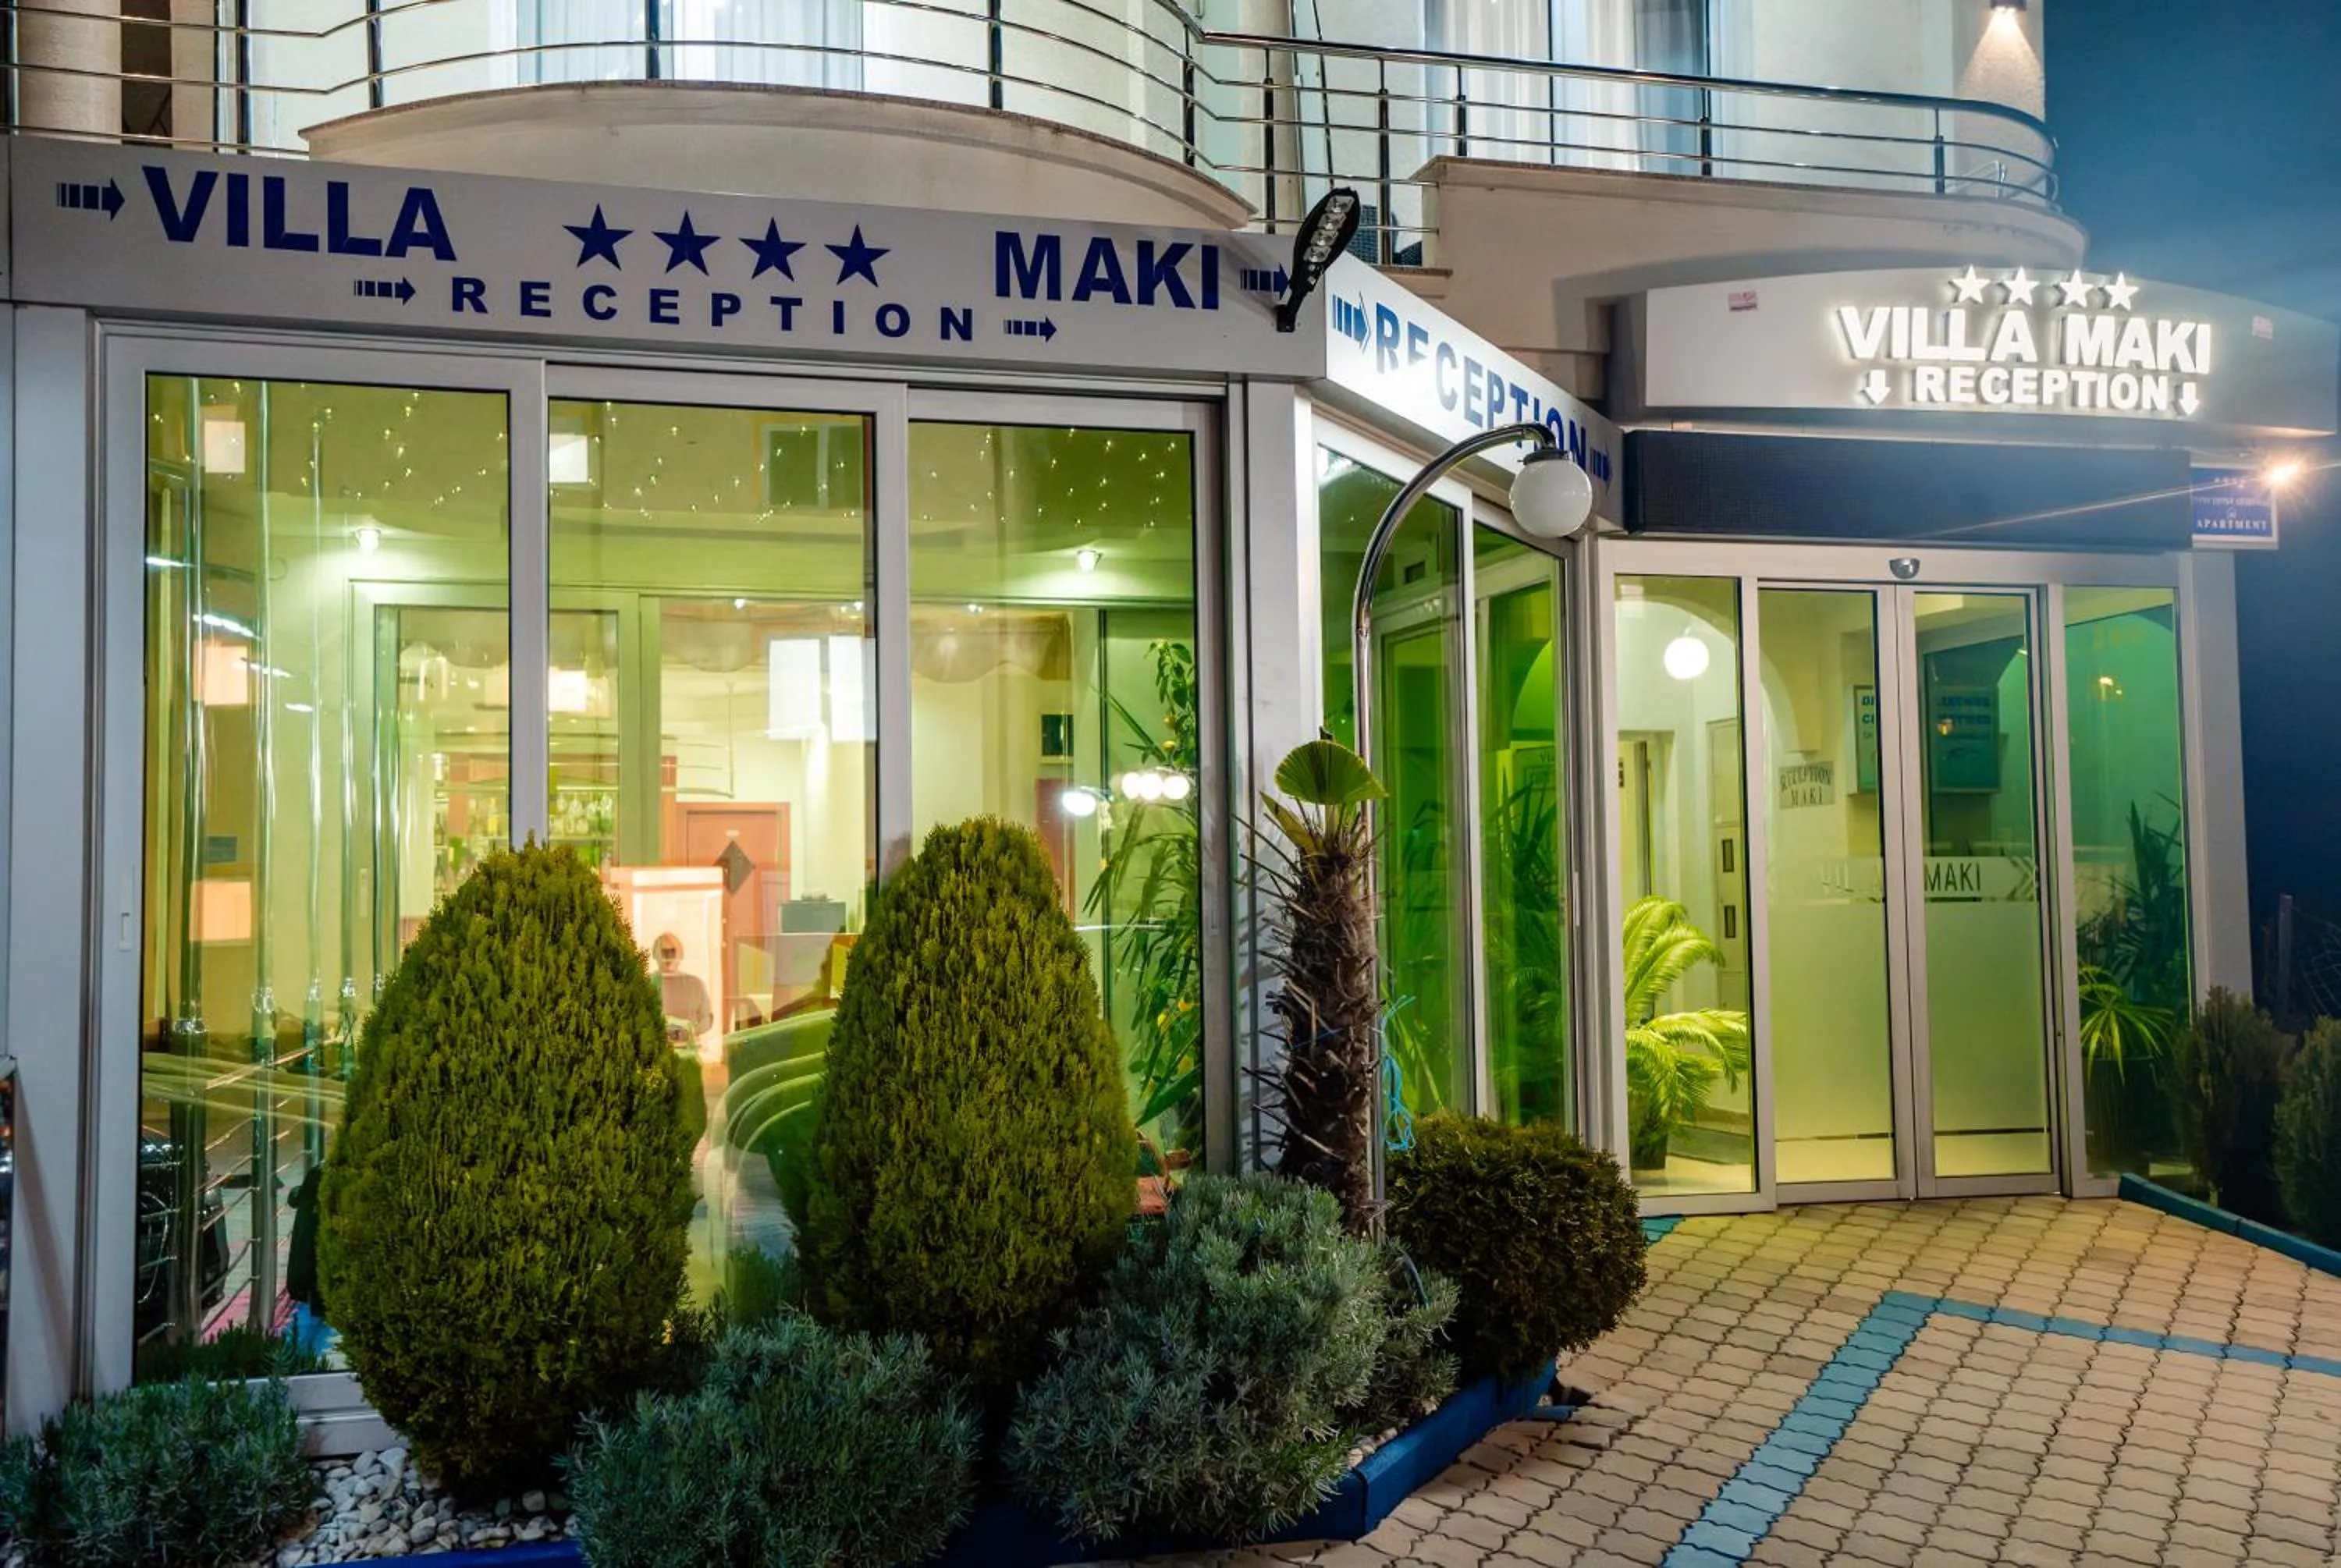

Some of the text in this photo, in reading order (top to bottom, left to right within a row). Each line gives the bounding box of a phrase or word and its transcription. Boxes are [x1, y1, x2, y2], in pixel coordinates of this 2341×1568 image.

[142, 165, 1220, 310] VILLA MAKI
[451, 276, 974, 342] RECEPTION
[1838, 306, 2211, 375] VILLA MAKI
[1915, 365, 2169, 410] RECEPTION
[2196, 518, 2268, 531] APARTMENT
[1924, 863, 1981, 892] MAKI
